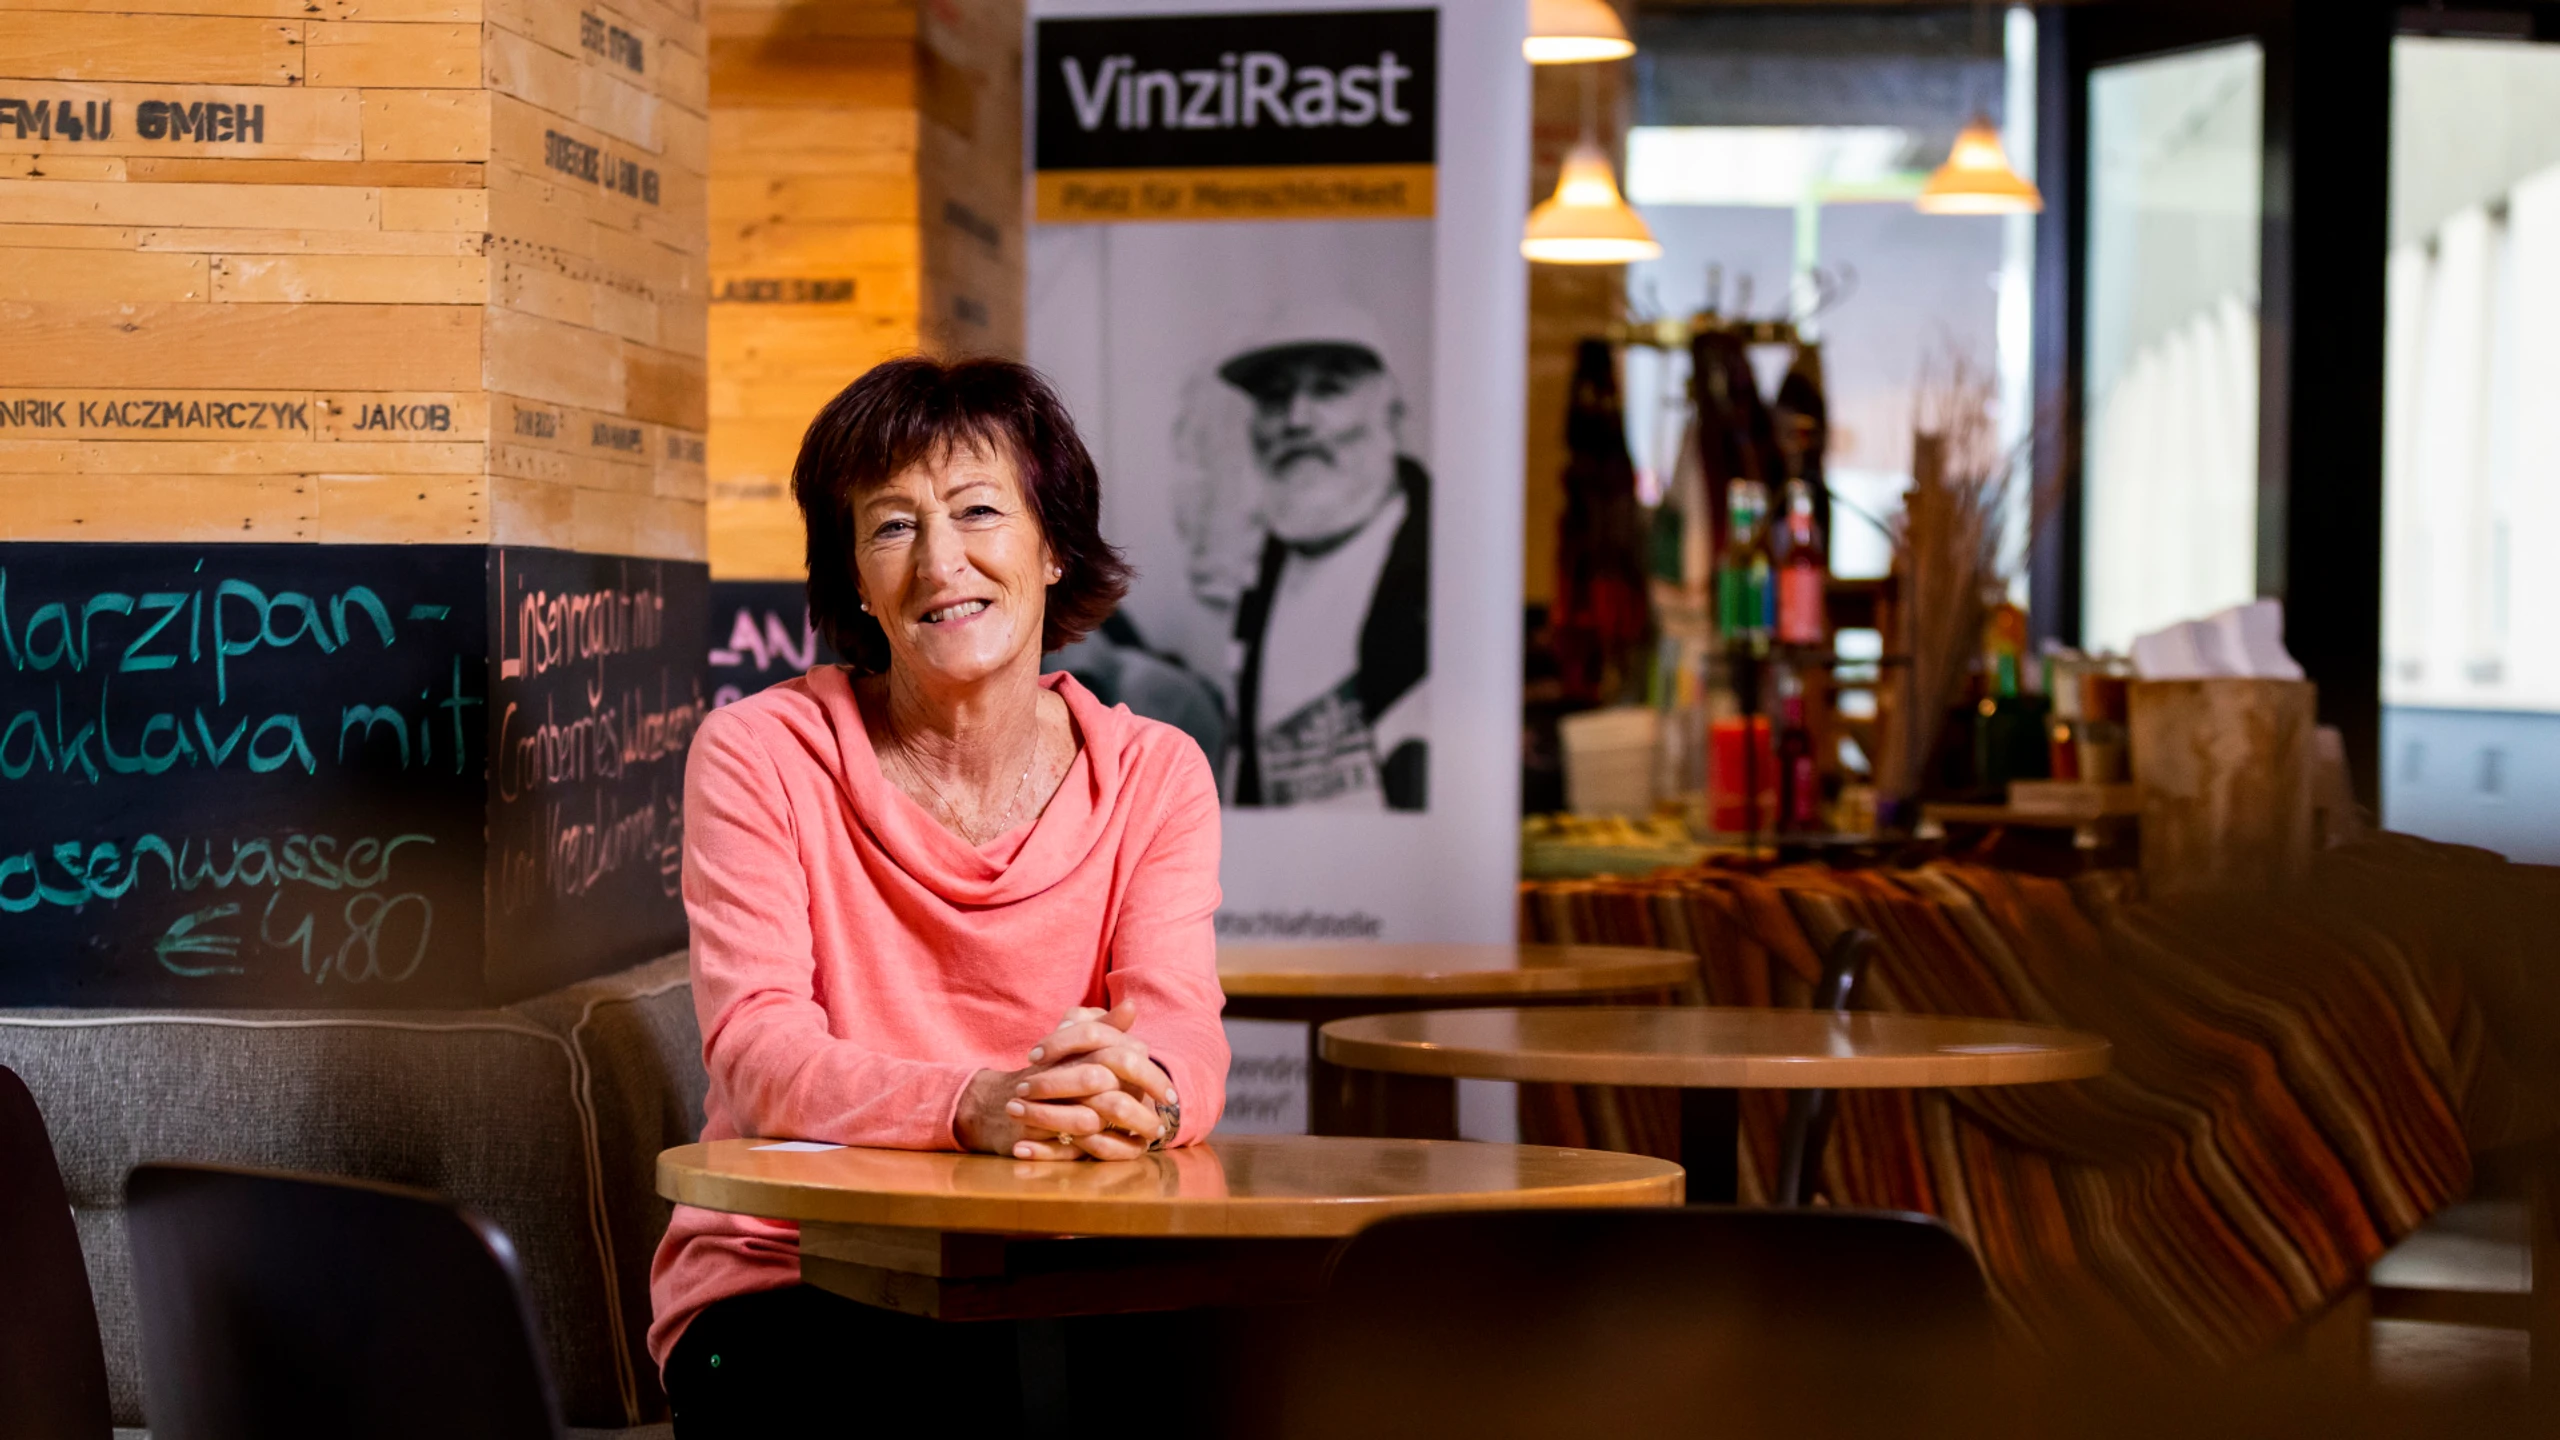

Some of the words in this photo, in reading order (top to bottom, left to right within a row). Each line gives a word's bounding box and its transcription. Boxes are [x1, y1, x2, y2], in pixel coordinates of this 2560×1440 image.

[136, 100, 264, 143] GMBH
[1061, 50, 1413, 131] VinziRast
[79, 399, 309, 430] KACZMARCZYK
[352, 403, 451, 432] JAKOB
[338, 653, 483, 775] mit
[157, 903, 244, 977] €
[262, 890, 432, 985] 4,80
